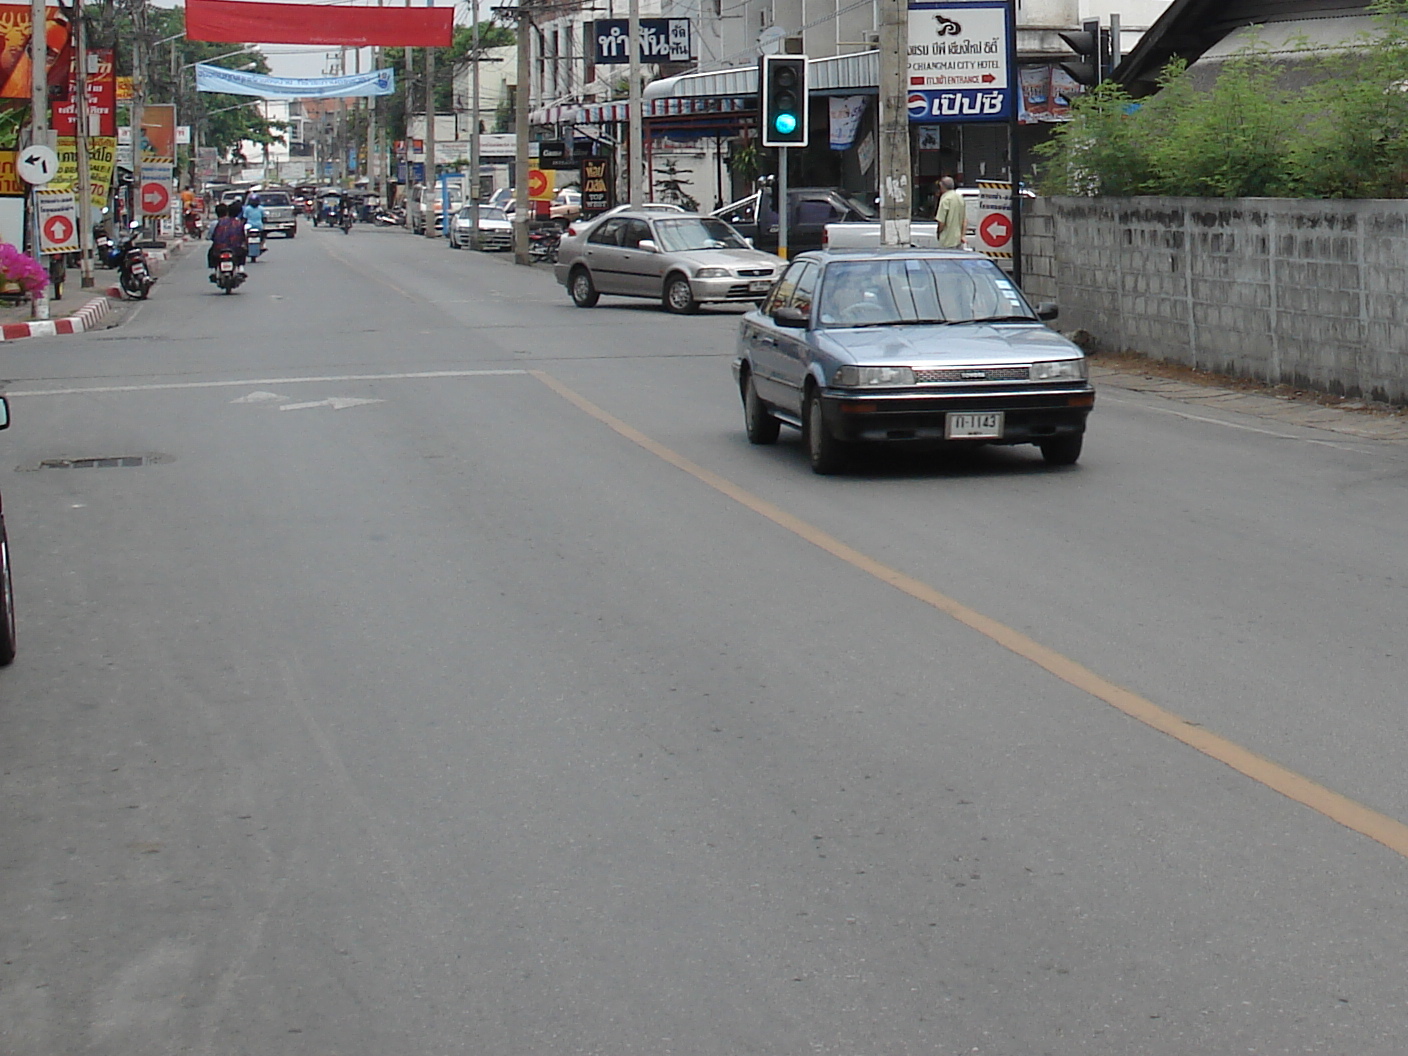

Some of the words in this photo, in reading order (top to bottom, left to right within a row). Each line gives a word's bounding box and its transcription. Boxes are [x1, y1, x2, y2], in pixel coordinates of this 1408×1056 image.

[913, 61, 956, 71] CHIANGMAI
[957, 61, 976, 70] CITY
[977, 60, 1000, 69] HOTEL
[948, 75, 979, 84] ENTRANCE
